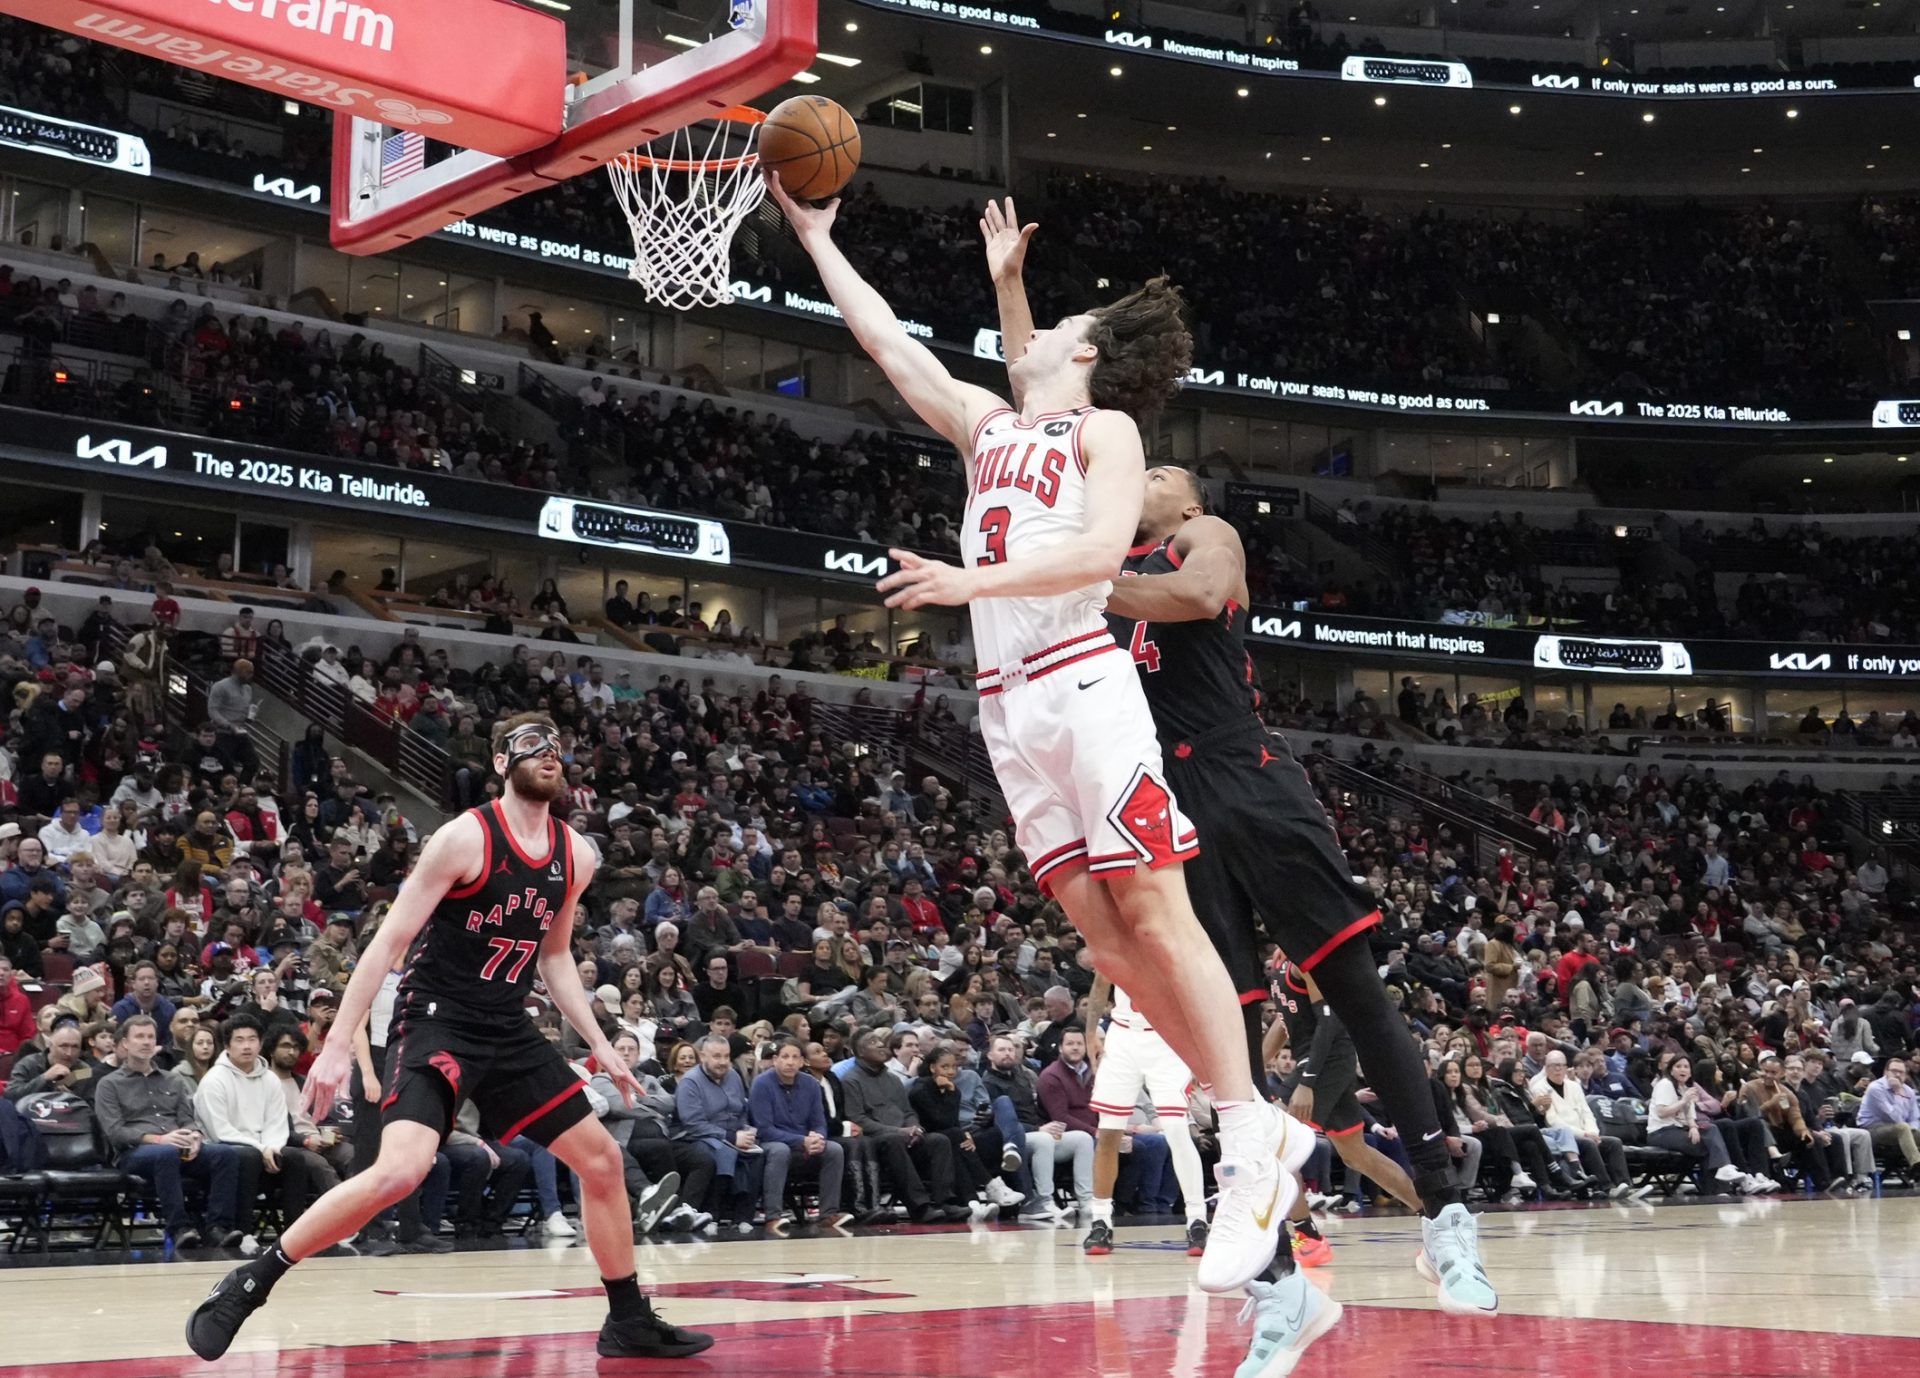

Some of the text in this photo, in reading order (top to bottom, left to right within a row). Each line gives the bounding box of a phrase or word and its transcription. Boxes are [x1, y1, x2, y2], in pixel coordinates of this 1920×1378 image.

[941, 2, 958, 15] as
[958, 5, 992, 21] good
[992, 11, 1008, 24] as
[1009, 14, 1041, 29] ours.
[1163, 39, 1299, 71] Movement that inspires
[1591, 77, 1838, 95] If only your seats were as good as ours.
[478, 225, 518, 246] were
[519, 235, 539, 251] as
[540, 240, 580, 260] good
[582, 249, 601, 265] as
[1237, 373, 1490, 411] If only your seats were as good as ours.
[1637, 402, 1791, 422] The 2025 Kia Telluride.
[192, 451, 430, 507] The 2025 Kia Telluride.
[977, 506, 1011, 567] 3
[1129, 620, 1161, 673] 4
[1314, 623, 1485, 655] Movement that inspires
[1847, 654, 1859, 670] If
[1862, 655, 1896, 675] only
[466, 888, 553, 932] RAPTOR
[480, 937, 538, 984] 77
